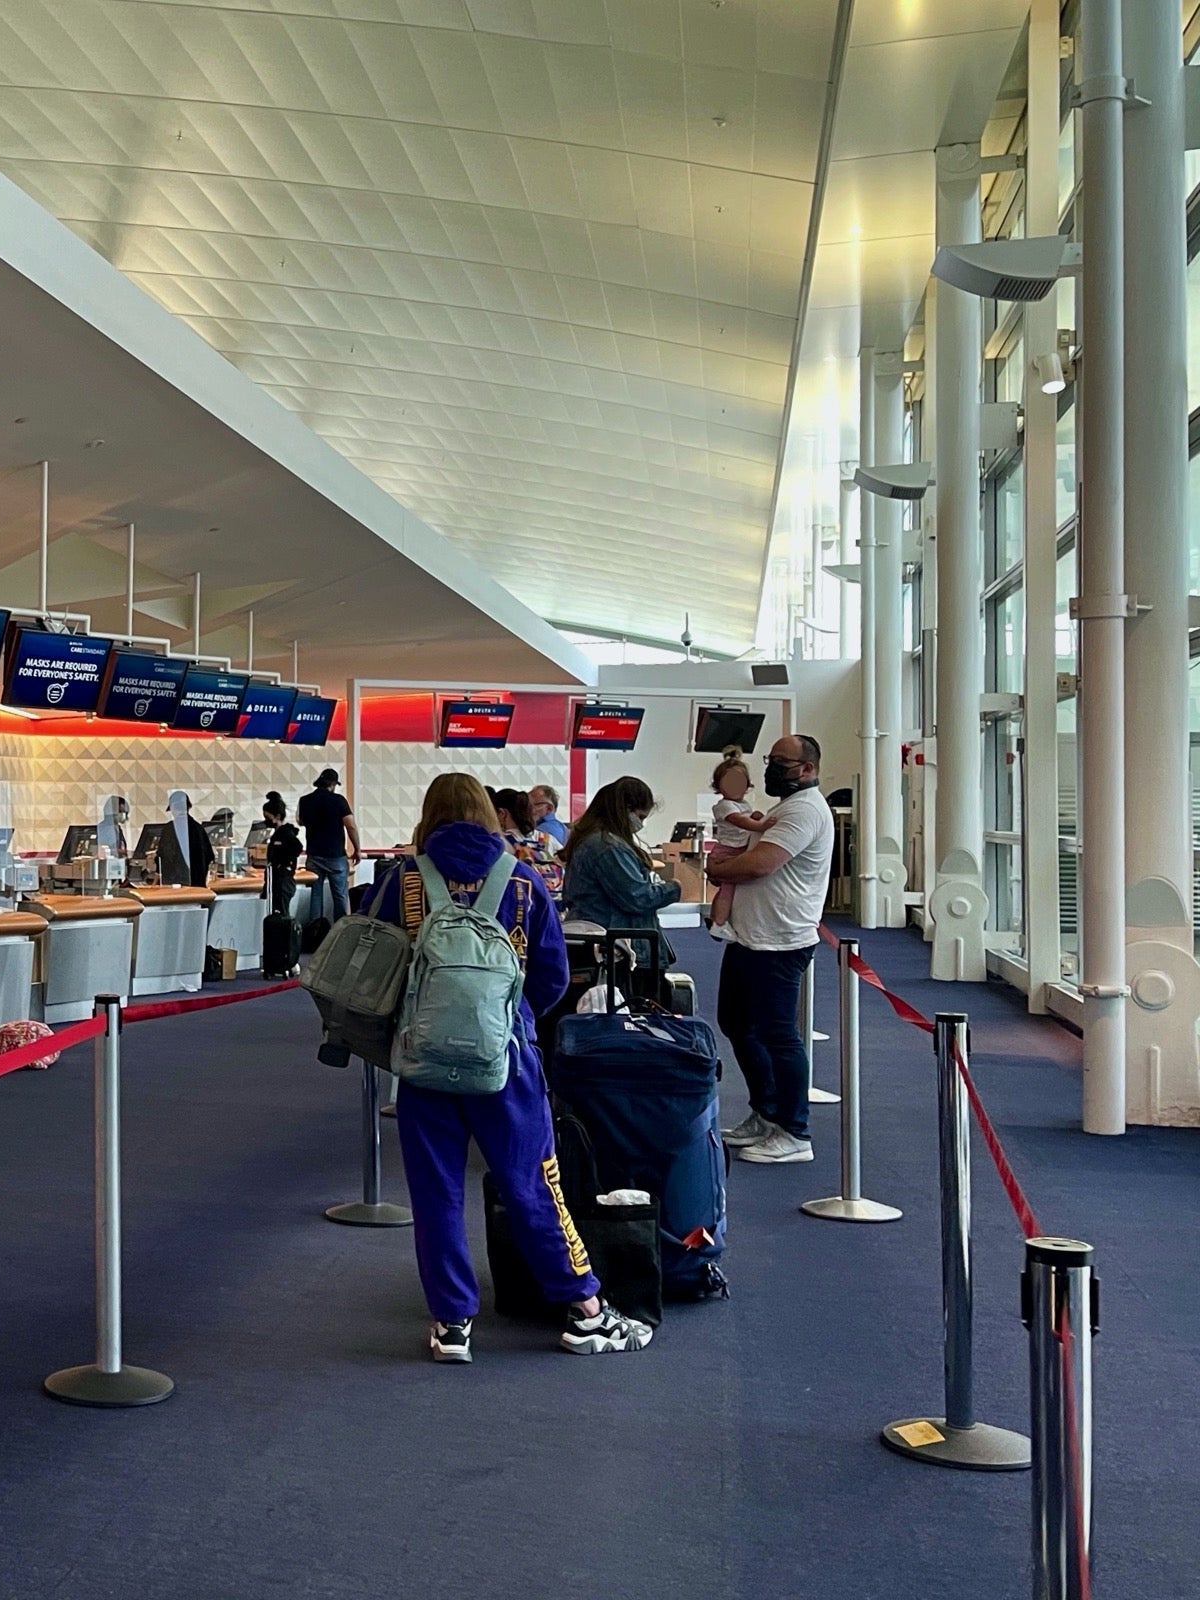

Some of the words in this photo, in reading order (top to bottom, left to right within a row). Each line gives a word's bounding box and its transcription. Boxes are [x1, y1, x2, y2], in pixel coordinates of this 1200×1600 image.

[25, 658, 51, 668] MASKS
[51, 660, 65, 669] ARE
[65, 661, 98, 672] REQUIRED
[19, 667, 33, 676] FOR
[33, 668, 74, 680] EVERYONE'S
[74, 672, 99, 682] SAFETY.
[119, 677, 138, 685] MASKS
[138, 679, 150, 687] ARE
[150, 680, 176, 689] REQUIRED
[113, 685, 124, 693] FOR
[213, 694, 238, 703] REQUIRED
[254, 704, 278, 713] DELTA
[302, 713, 320, 721] DELTA
